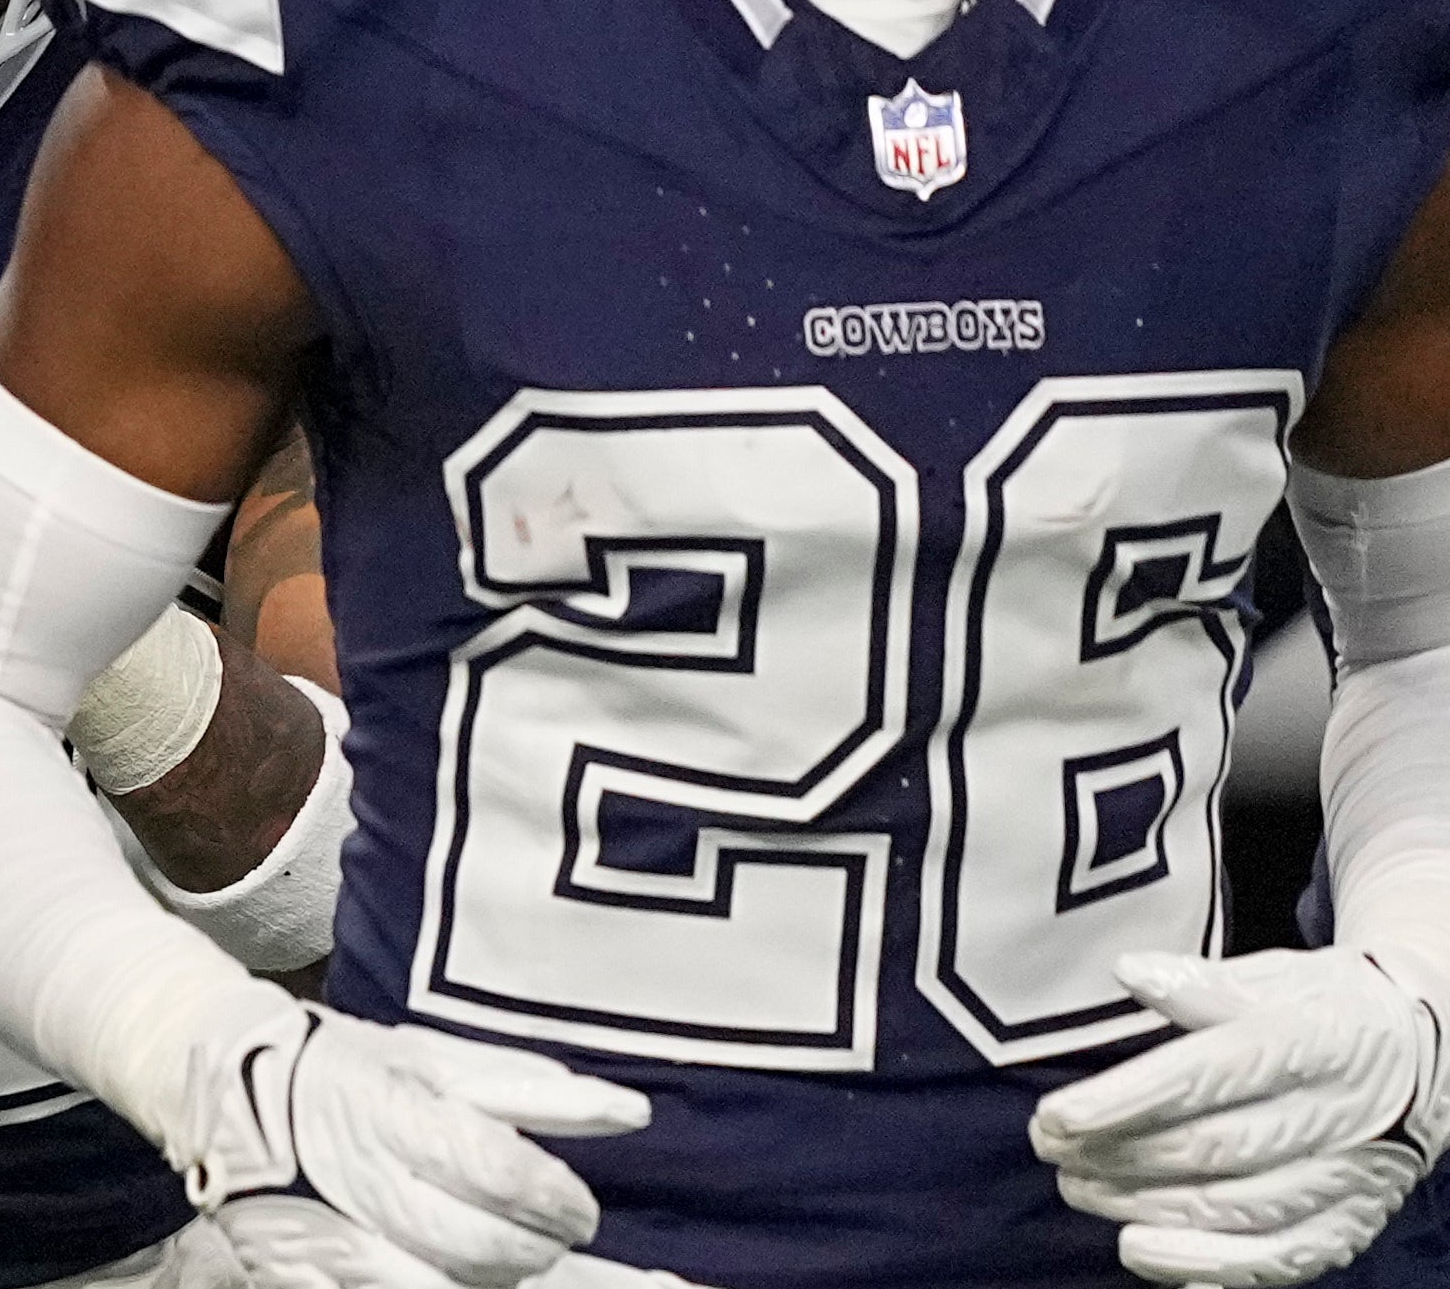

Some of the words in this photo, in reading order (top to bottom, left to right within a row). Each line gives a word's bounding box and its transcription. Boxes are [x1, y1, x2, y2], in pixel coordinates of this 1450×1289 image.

[891, 134, 951, 175] NFL
[803, 299, 1046, 356] COWBOYS
[408, 367, 1306, 1073] 26
